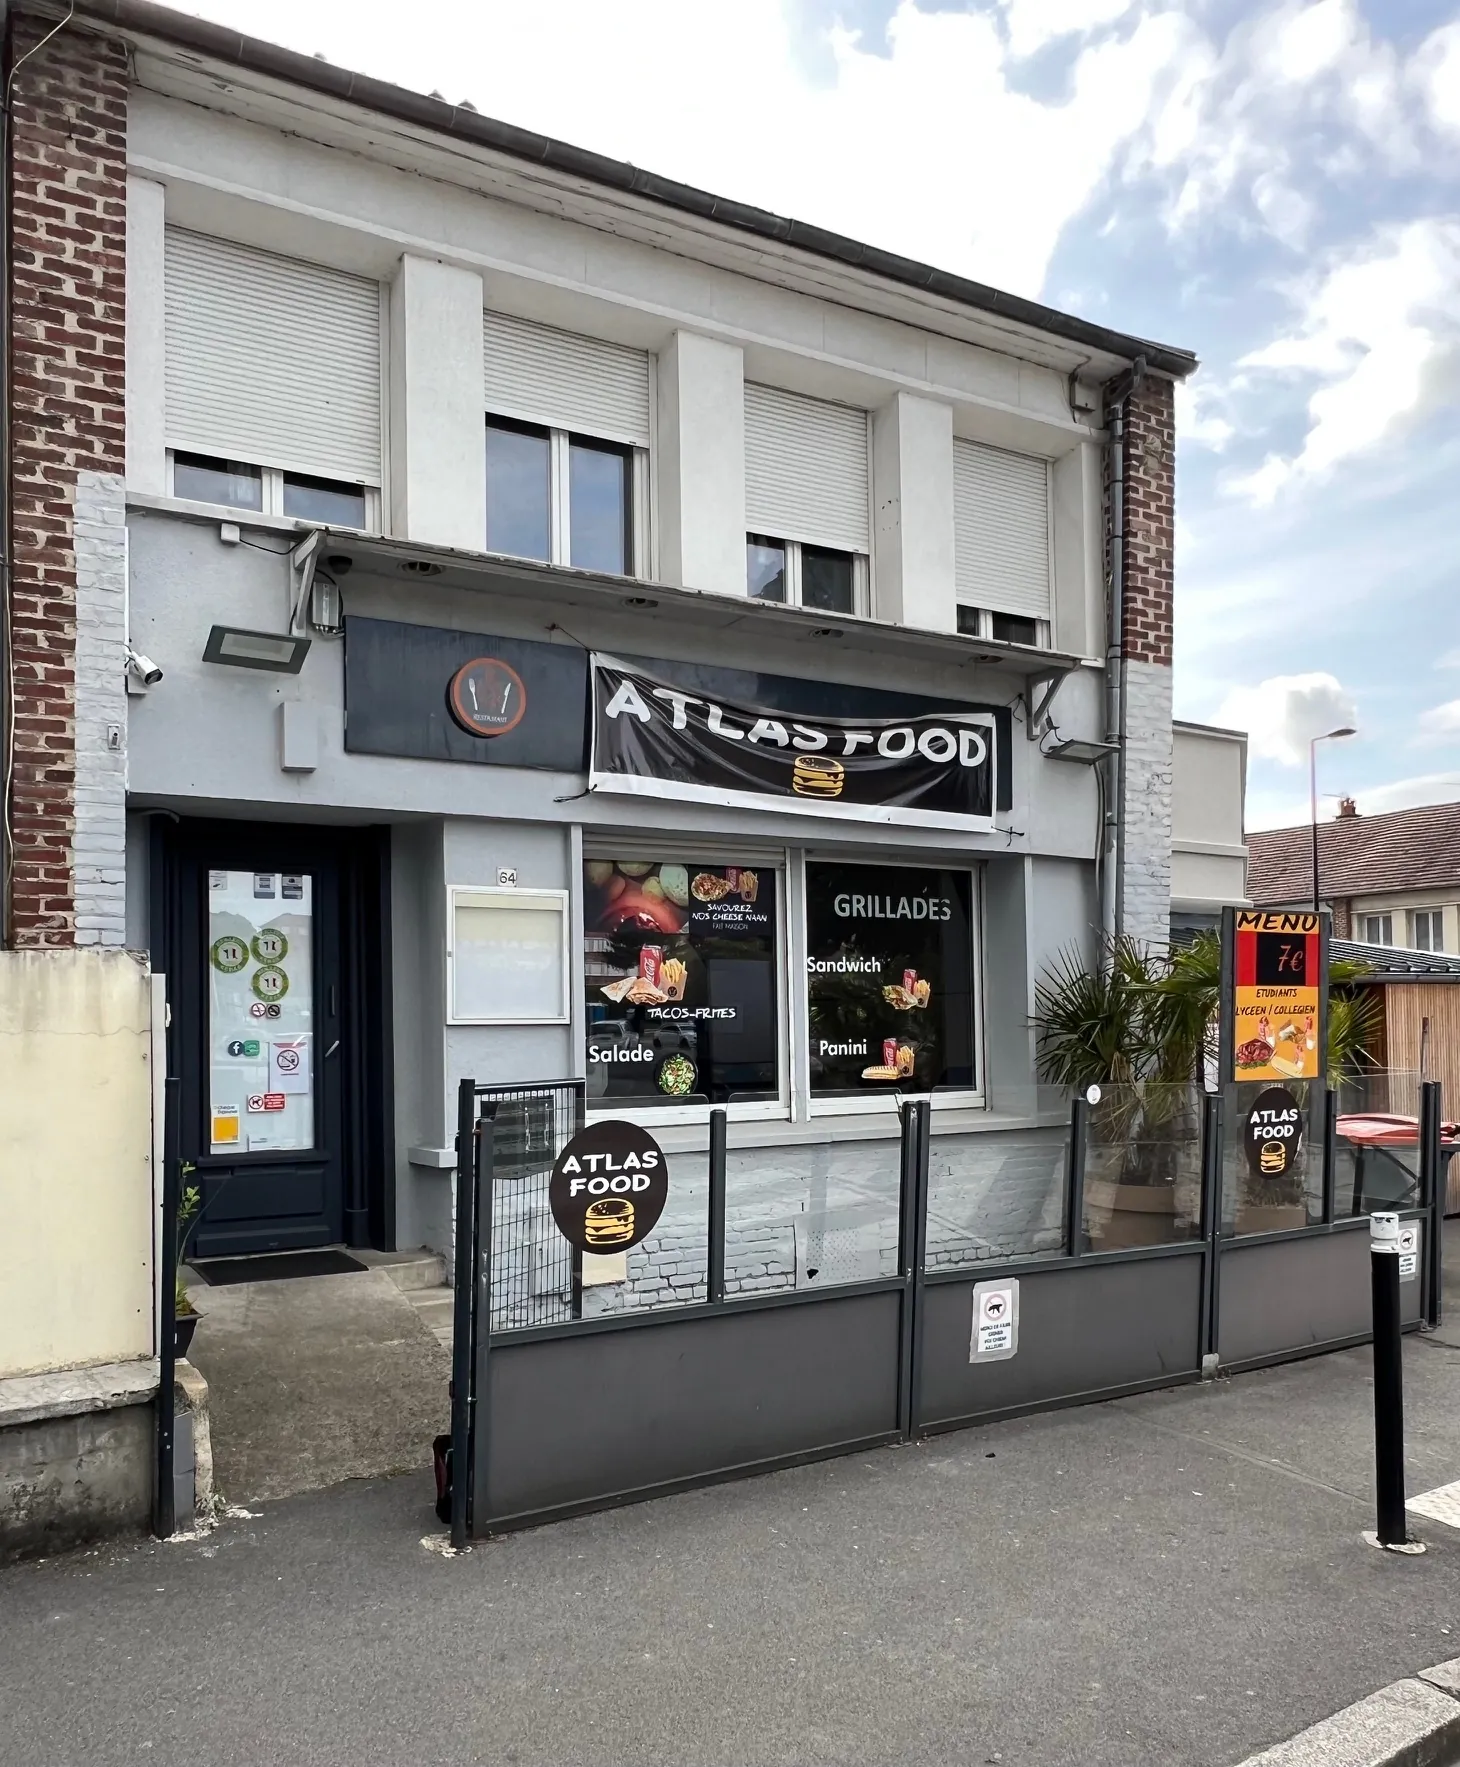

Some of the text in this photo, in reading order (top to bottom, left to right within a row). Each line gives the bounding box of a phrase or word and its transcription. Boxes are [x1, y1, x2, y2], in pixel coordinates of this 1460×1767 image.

[605, 680, 986, 767] ATLAS FOOD
[500, 871, 517, 885] 64
[707, 903, 753, 913] SAVOUREZ
[834, 893, 952, 921] GRILLADES
[691, 912, 768, 922] NOS CHEESE NAAN
[1237, 911, 1318, 932] MENU
[806, 956, 881, 973] Sandwich
[1278, 944, 1304, 972] 7€
[1256, 988, 1298, 998] ETUDIANTS
[647, 1007, 736, 1019] TACOS-FRITES
[1235, 1005, 1267, 1016] LYCEEN
[1273, 1005, 1316, 1015] COLLEGIEN
[589, 1043, 654, 1063] Salade
[820, 1038, 868, 1056] Panini
[1250, 1108, 1299, 1124] ATLAS
[1253, 1124, 1295, 1141] FOOD
[561, 1150, 659, 1175] ATLAS
[569, 1173, 651, 1198] FOOD
